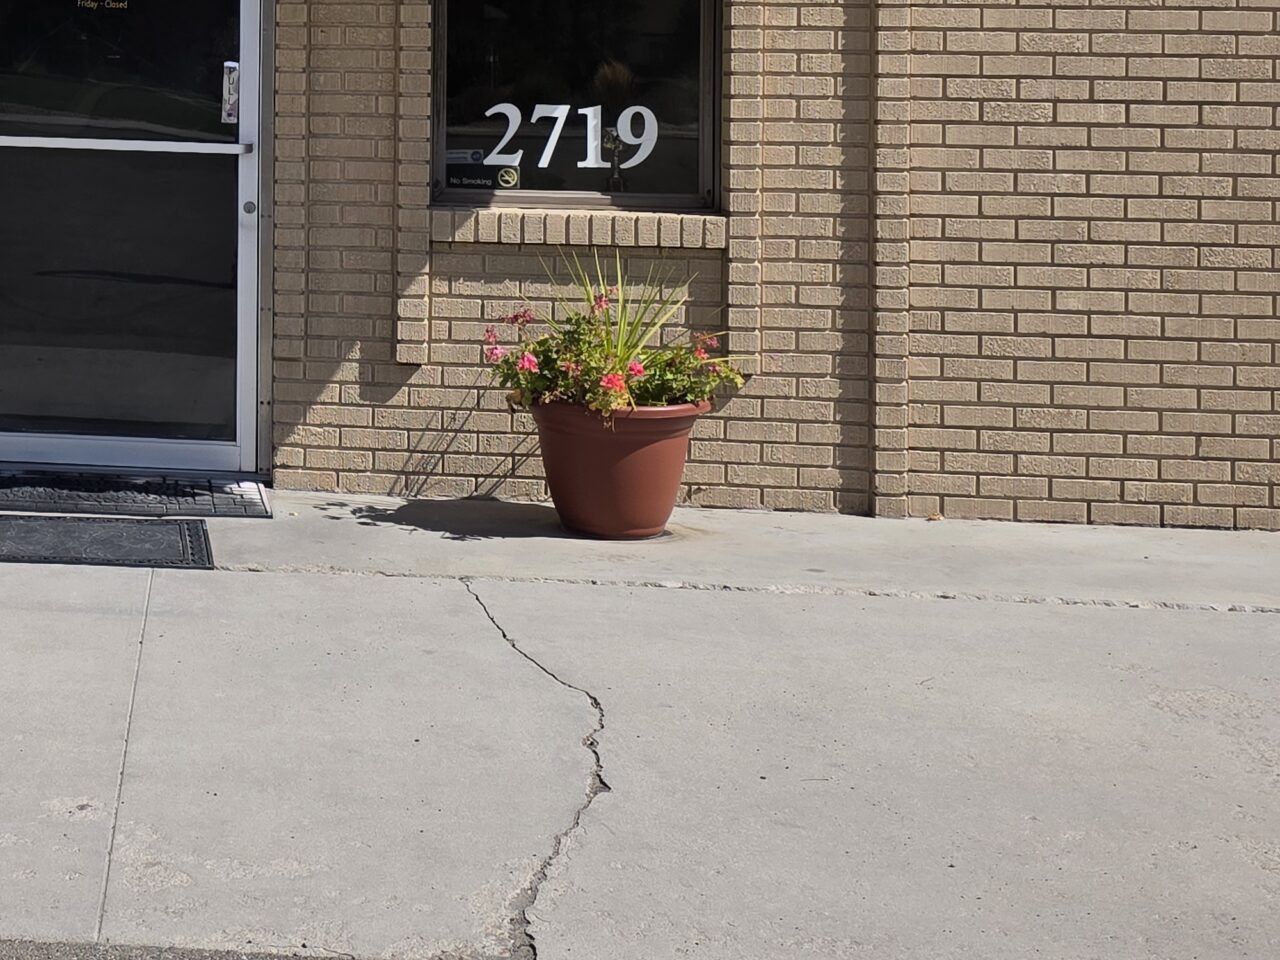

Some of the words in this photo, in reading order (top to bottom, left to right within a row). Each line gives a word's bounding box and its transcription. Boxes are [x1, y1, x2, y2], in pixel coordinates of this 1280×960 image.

[104, 0, 128, 9] Closed
[482, 102, 659, 170] 2719
[462, 177, 492, 186] Smoking
